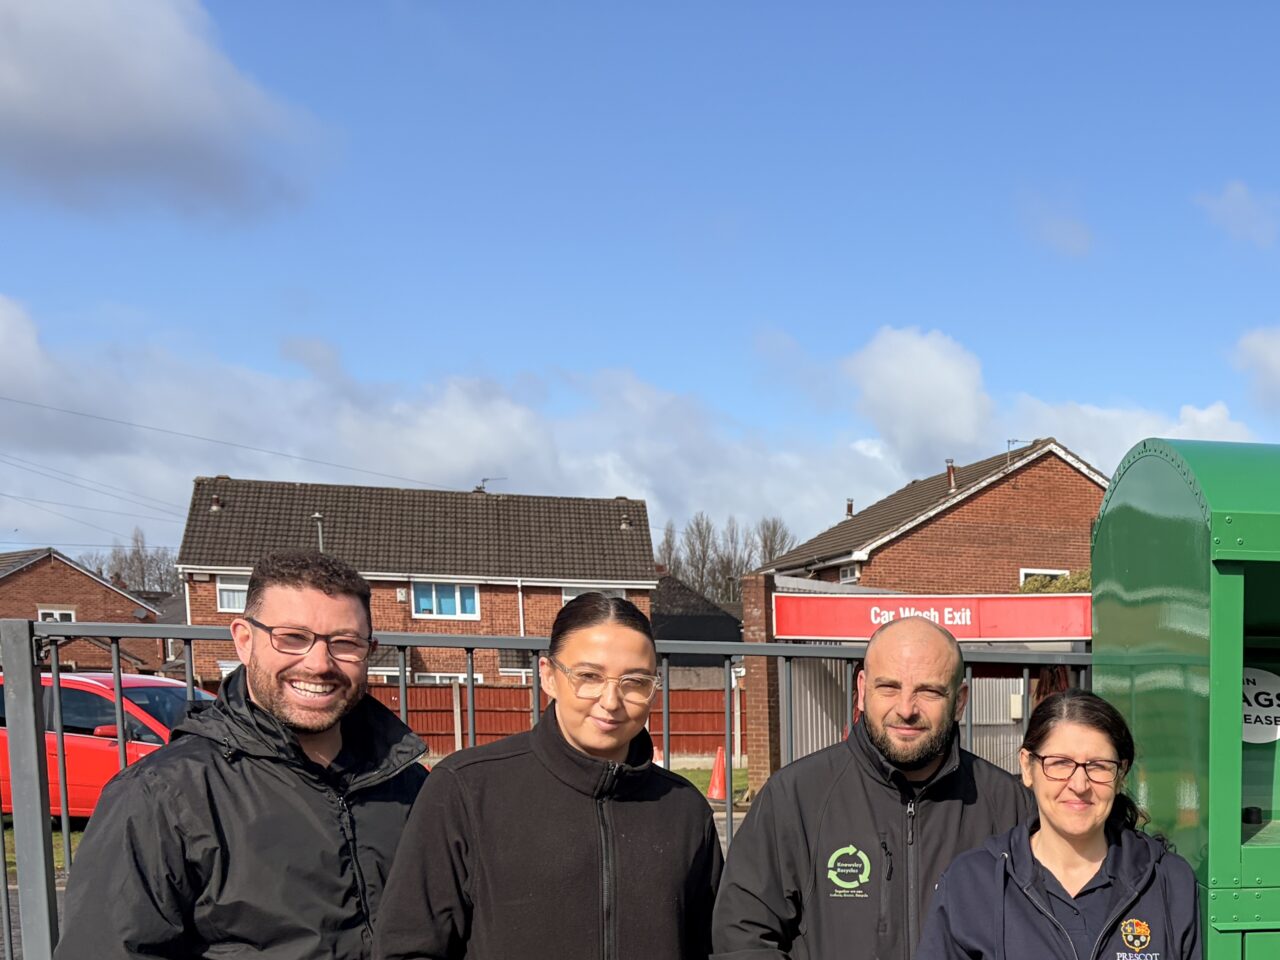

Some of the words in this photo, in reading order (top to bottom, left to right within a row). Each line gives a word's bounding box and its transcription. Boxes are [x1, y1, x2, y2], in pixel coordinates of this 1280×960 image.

[870, 606, 895, 624] Car
[943, 608, 971, 625] Exit
[1116, 952, 1160, 960] PRESCOT
